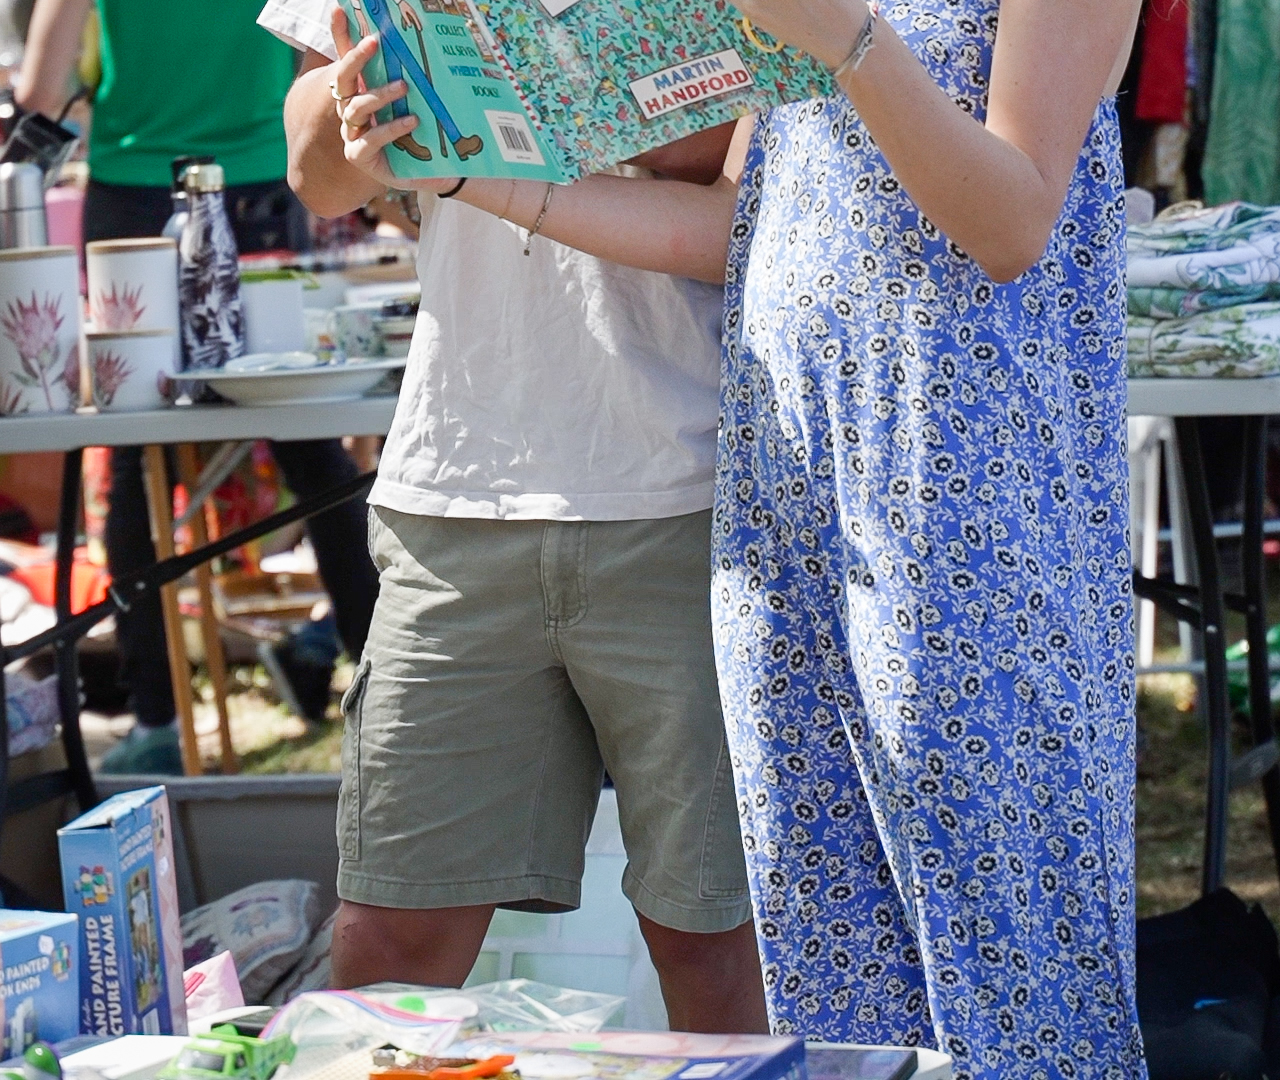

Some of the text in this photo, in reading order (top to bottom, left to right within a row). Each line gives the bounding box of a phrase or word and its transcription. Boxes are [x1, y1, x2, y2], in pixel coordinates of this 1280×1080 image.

[435, 24, 466, 37] COLLECT
[441, 45, 478, 57] ALL SEVEN
[645, 70, 749, 114] HANDFORD
[653, 57, 724, 91] MARTIN
[6, 956, 50, 980] PAINTED
[85, 916, 105, 995] PAINTED
[99, 913, 124, 1036] CTURE FRAME
[93, 999, 108, 1038] AND
